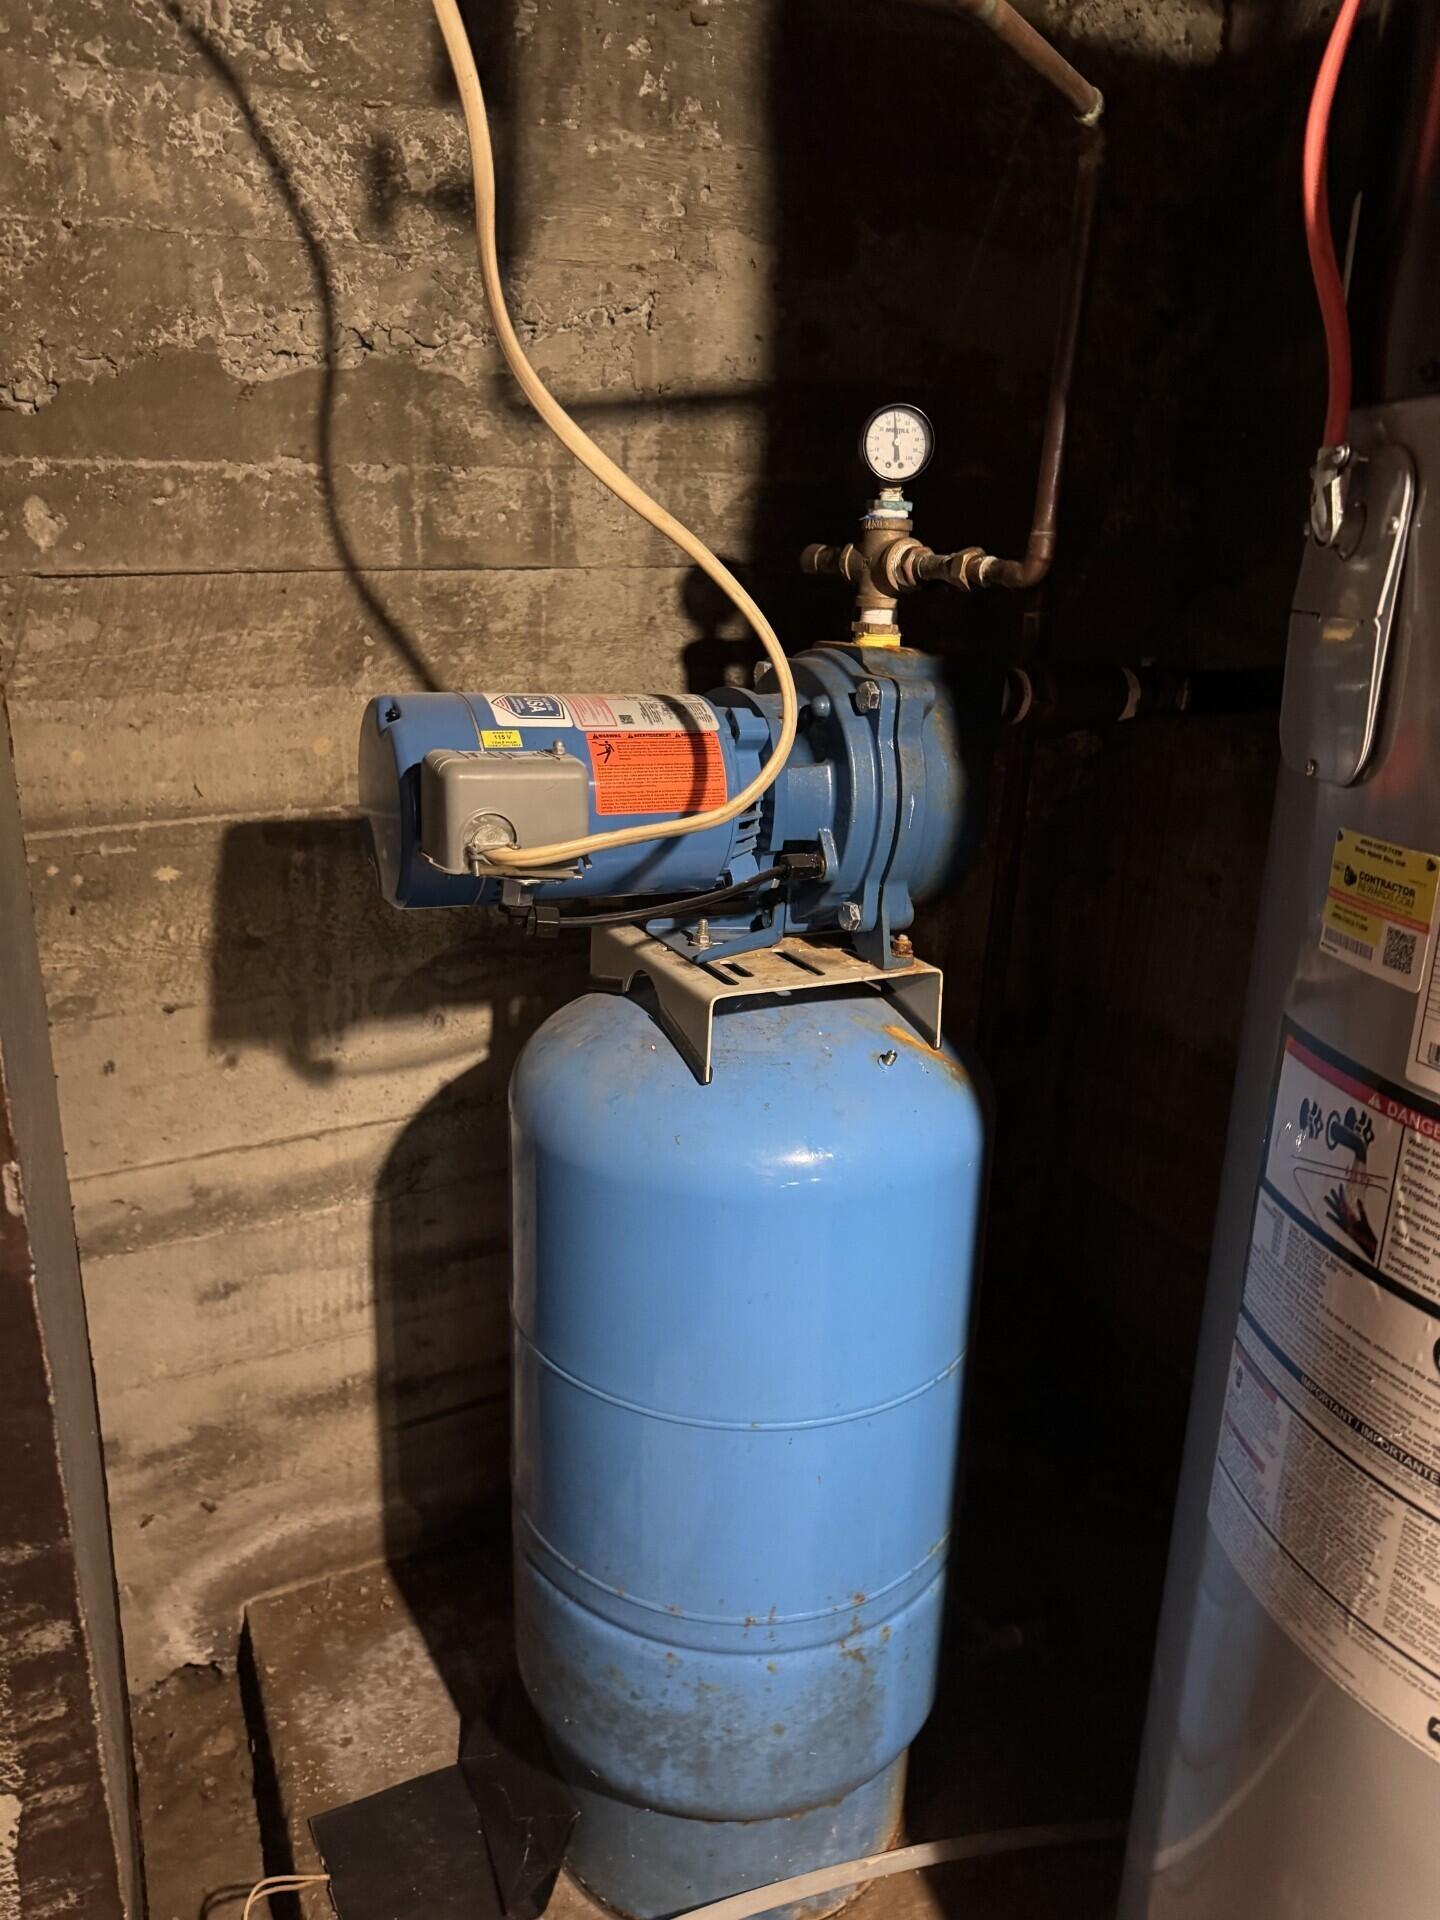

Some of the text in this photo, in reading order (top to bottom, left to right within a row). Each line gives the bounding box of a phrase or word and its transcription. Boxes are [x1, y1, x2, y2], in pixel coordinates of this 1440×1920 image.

[1359, 871, 1416, 898] CONTRACTOR
[1301, 1374, 1353, 1424] IMPORTANT
[1360, 1424, 1440, 1481] IMPORTANTE
